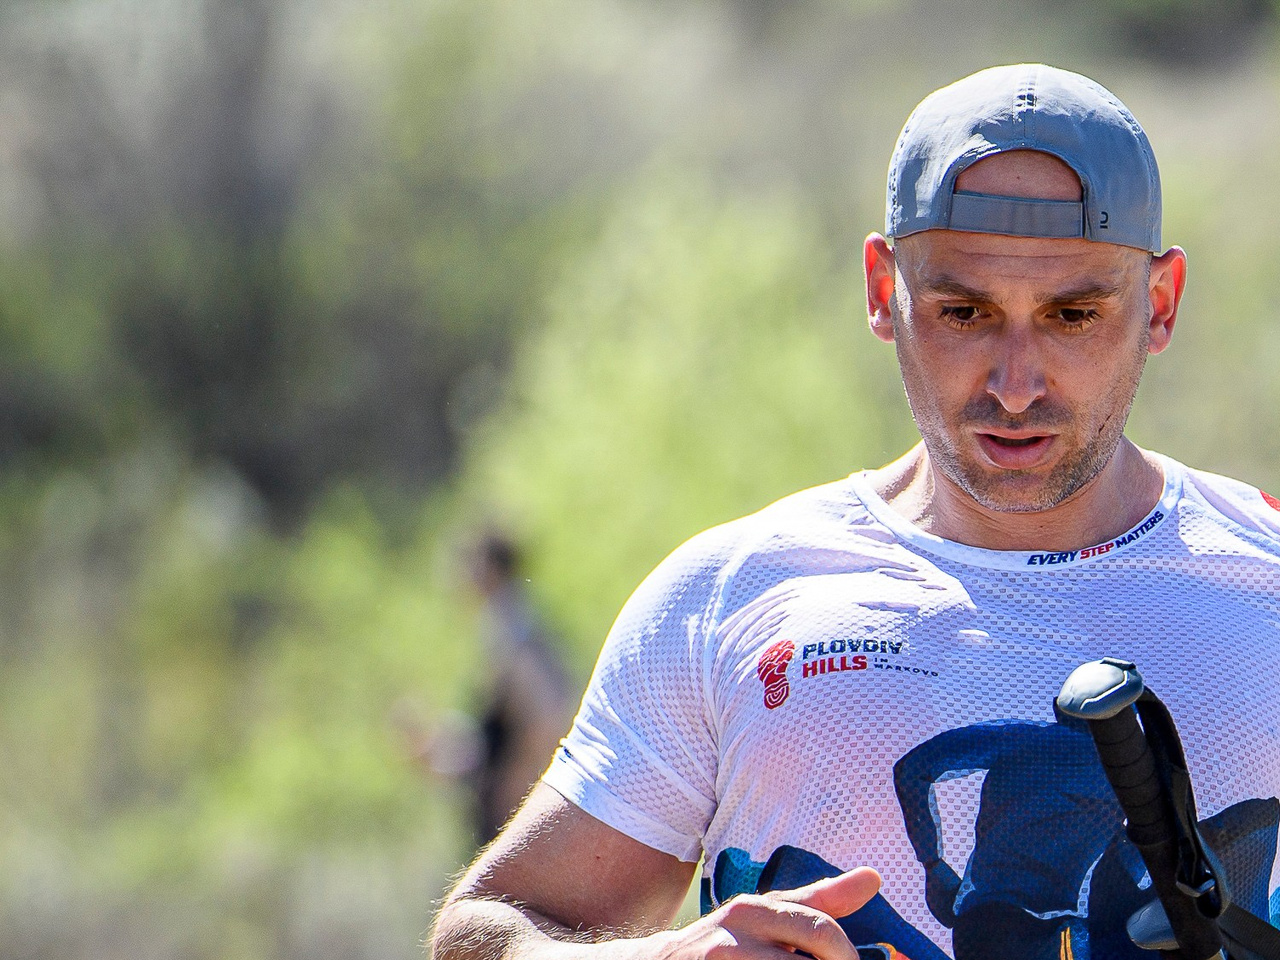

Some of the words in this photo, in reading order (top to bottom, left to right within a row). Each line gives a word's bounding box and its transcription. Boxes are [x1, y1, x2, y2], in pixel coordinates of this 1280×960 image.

[1027, 551, 1078, 565] EVERY
[1080, 543, 1114, 559] STEP
[1116, 511, 1164, 548] MATTERS
[802, 639, 902, 660] PLOVDIV
[802, 655, 868, 678] HILLS
[874, 664, 939, 677] MARKOVO
